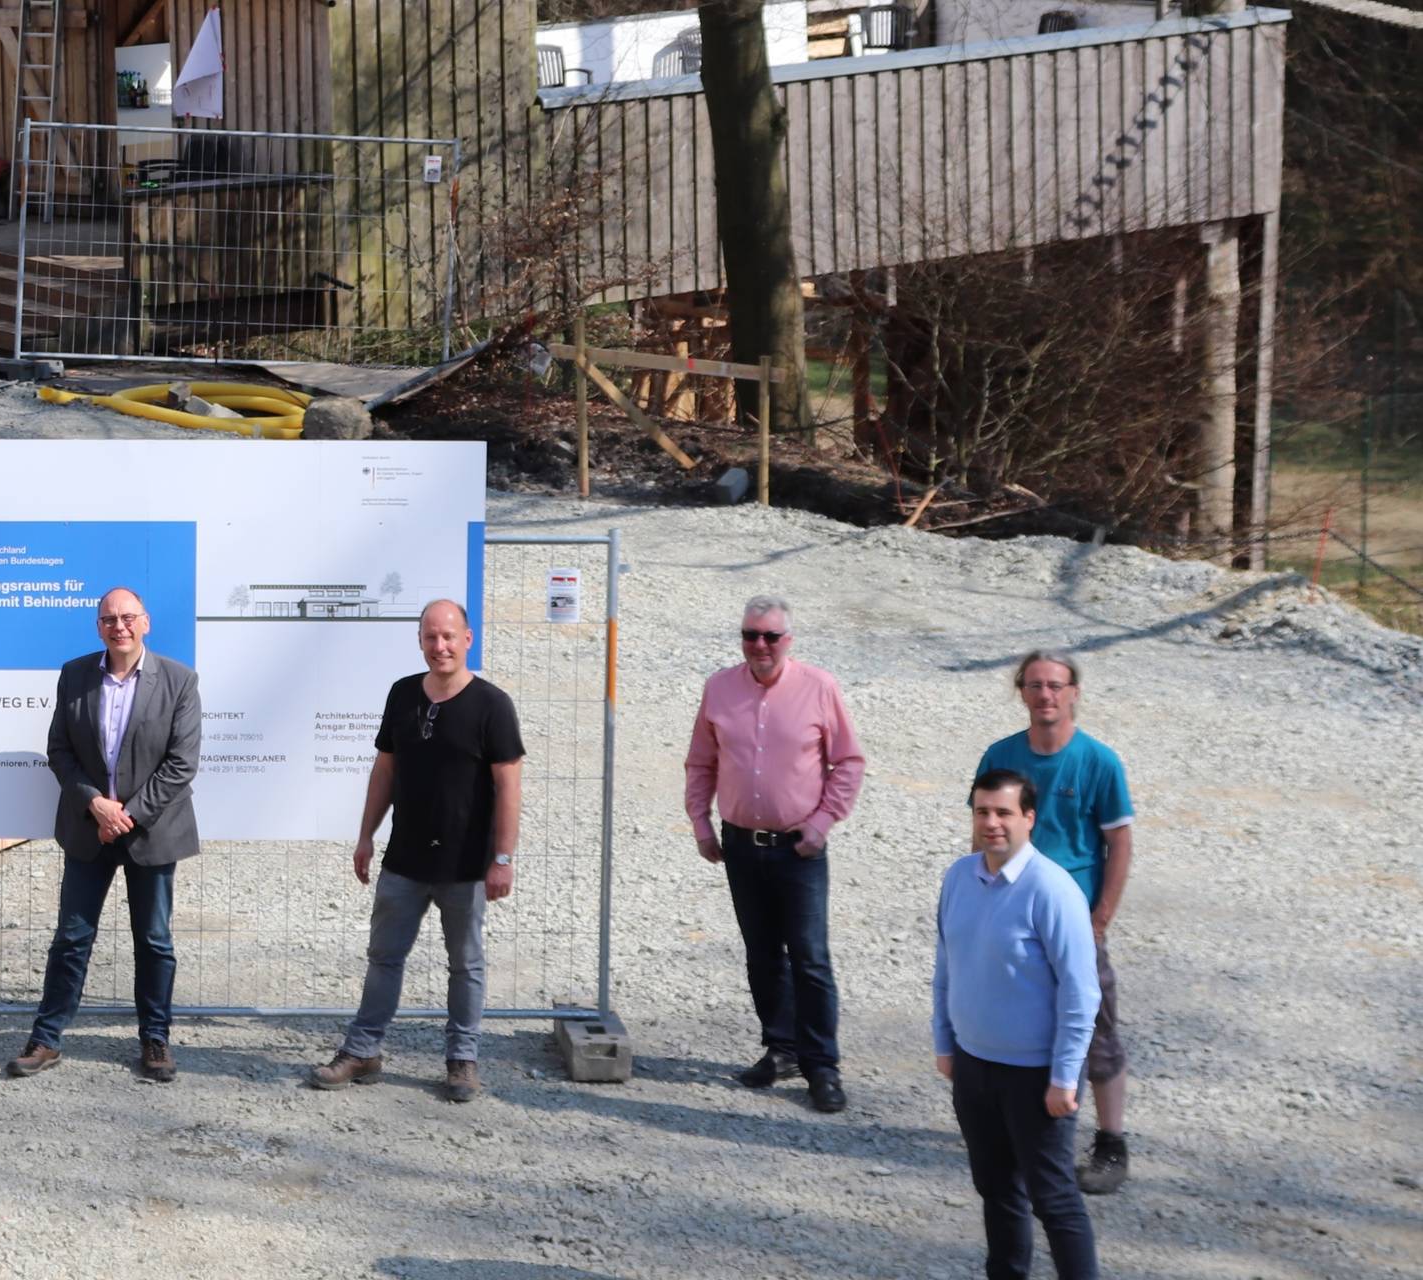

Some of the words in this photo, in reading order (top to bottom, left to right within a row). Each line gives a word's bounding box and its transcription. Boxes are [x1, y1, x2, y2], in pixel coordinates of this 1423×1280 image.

[10, 556, 64, 566] Bundestages
[64, 579, 85, 591] für
[26, 697, 51, 708] E.V.
[201, 712, 245, 720] RCHITEKT
[315, 712, 383, 720] Architekturbüro
[315, 723, 347, 732] Ansgar
[349, 723, 381, 731] Bültma
[33, 759, 49, 768] Fra
[200, 755, 286, 763] RAGWERKSPLANER
